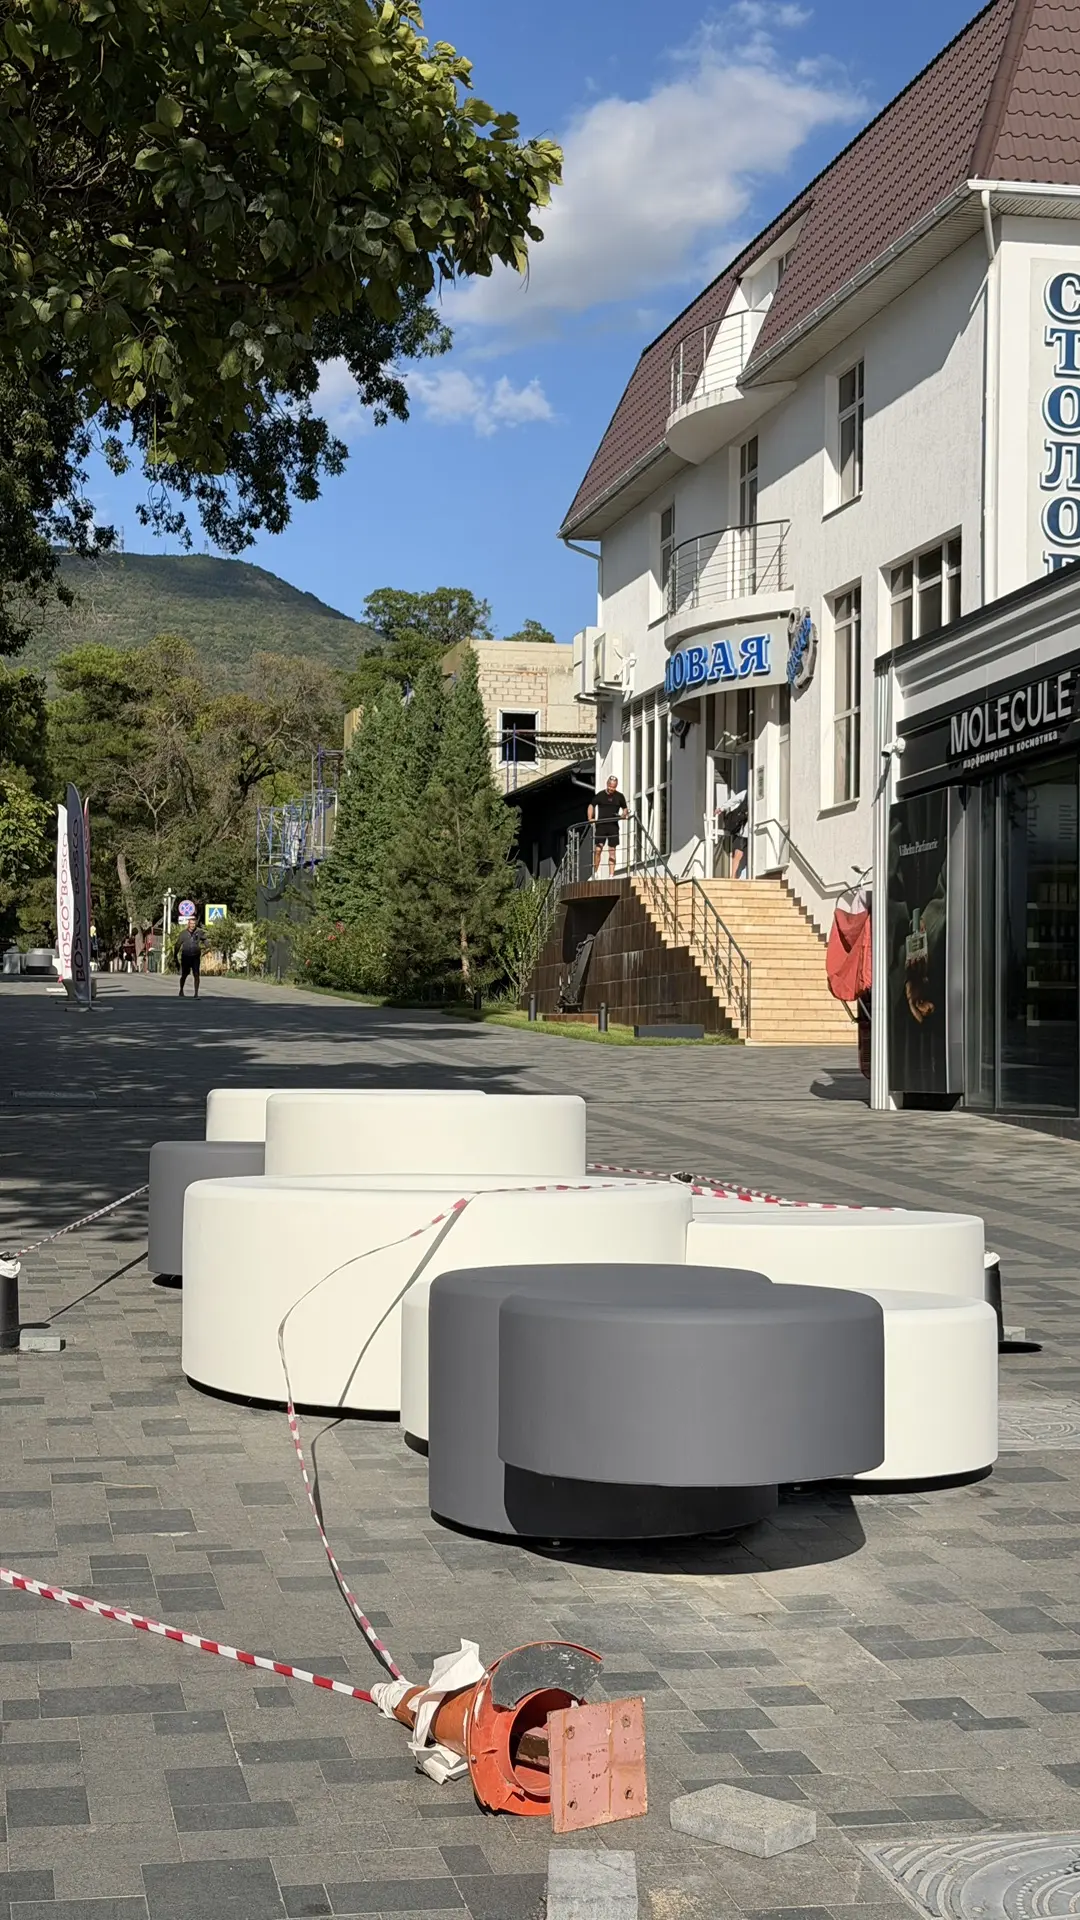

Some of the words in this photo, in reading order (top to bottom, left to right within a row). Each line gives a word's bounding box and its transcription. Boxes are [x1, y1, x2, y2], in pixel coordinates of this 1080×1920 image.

[1040, 269, 1080, 577] СТОЛО
[950, 671, 1072, 756] MOLECULE
[962, 747, 1008, 770] парфюмерия
[1009, 744, 1015, 755] и
[1016, 730, 1058, 752] косметика
